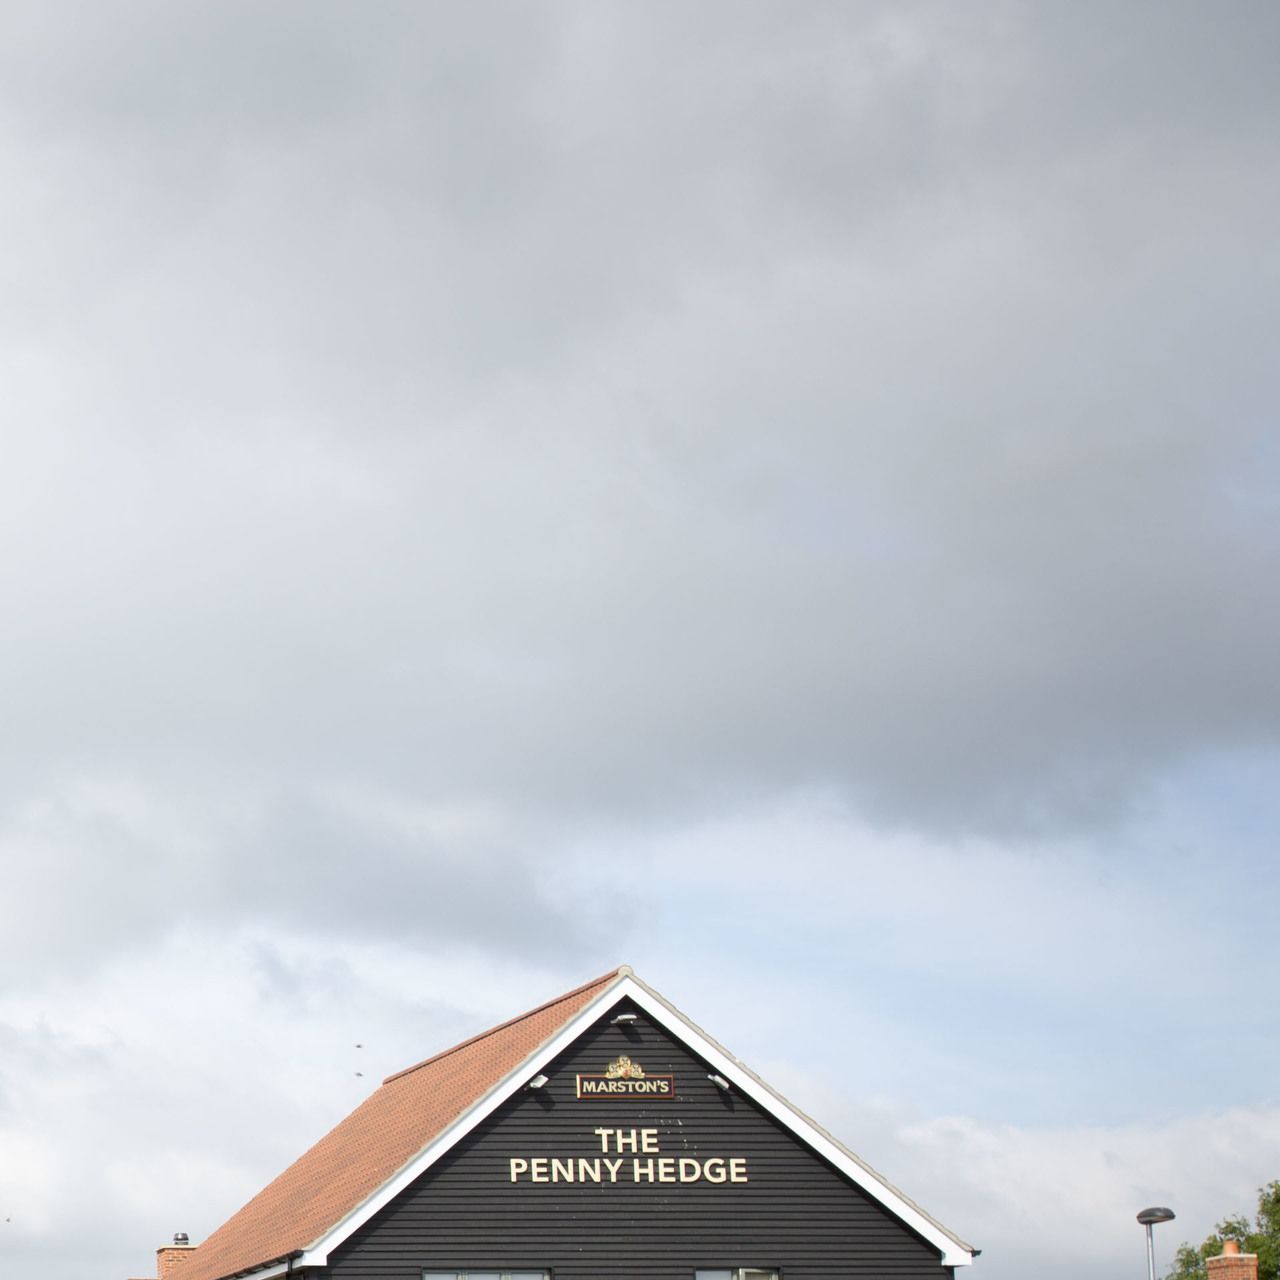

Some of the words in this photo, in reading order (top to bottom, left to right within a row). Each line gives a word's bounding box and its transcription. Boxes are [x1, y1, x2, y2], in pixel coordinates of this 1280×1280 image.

[582, 1080, 670, 1093] MARSTON'S
[594, 1128, 659, 1153] THE
[509, 1158, 623, 1183] PENNY
[633, 1158, 748, 1183] HEDGE
